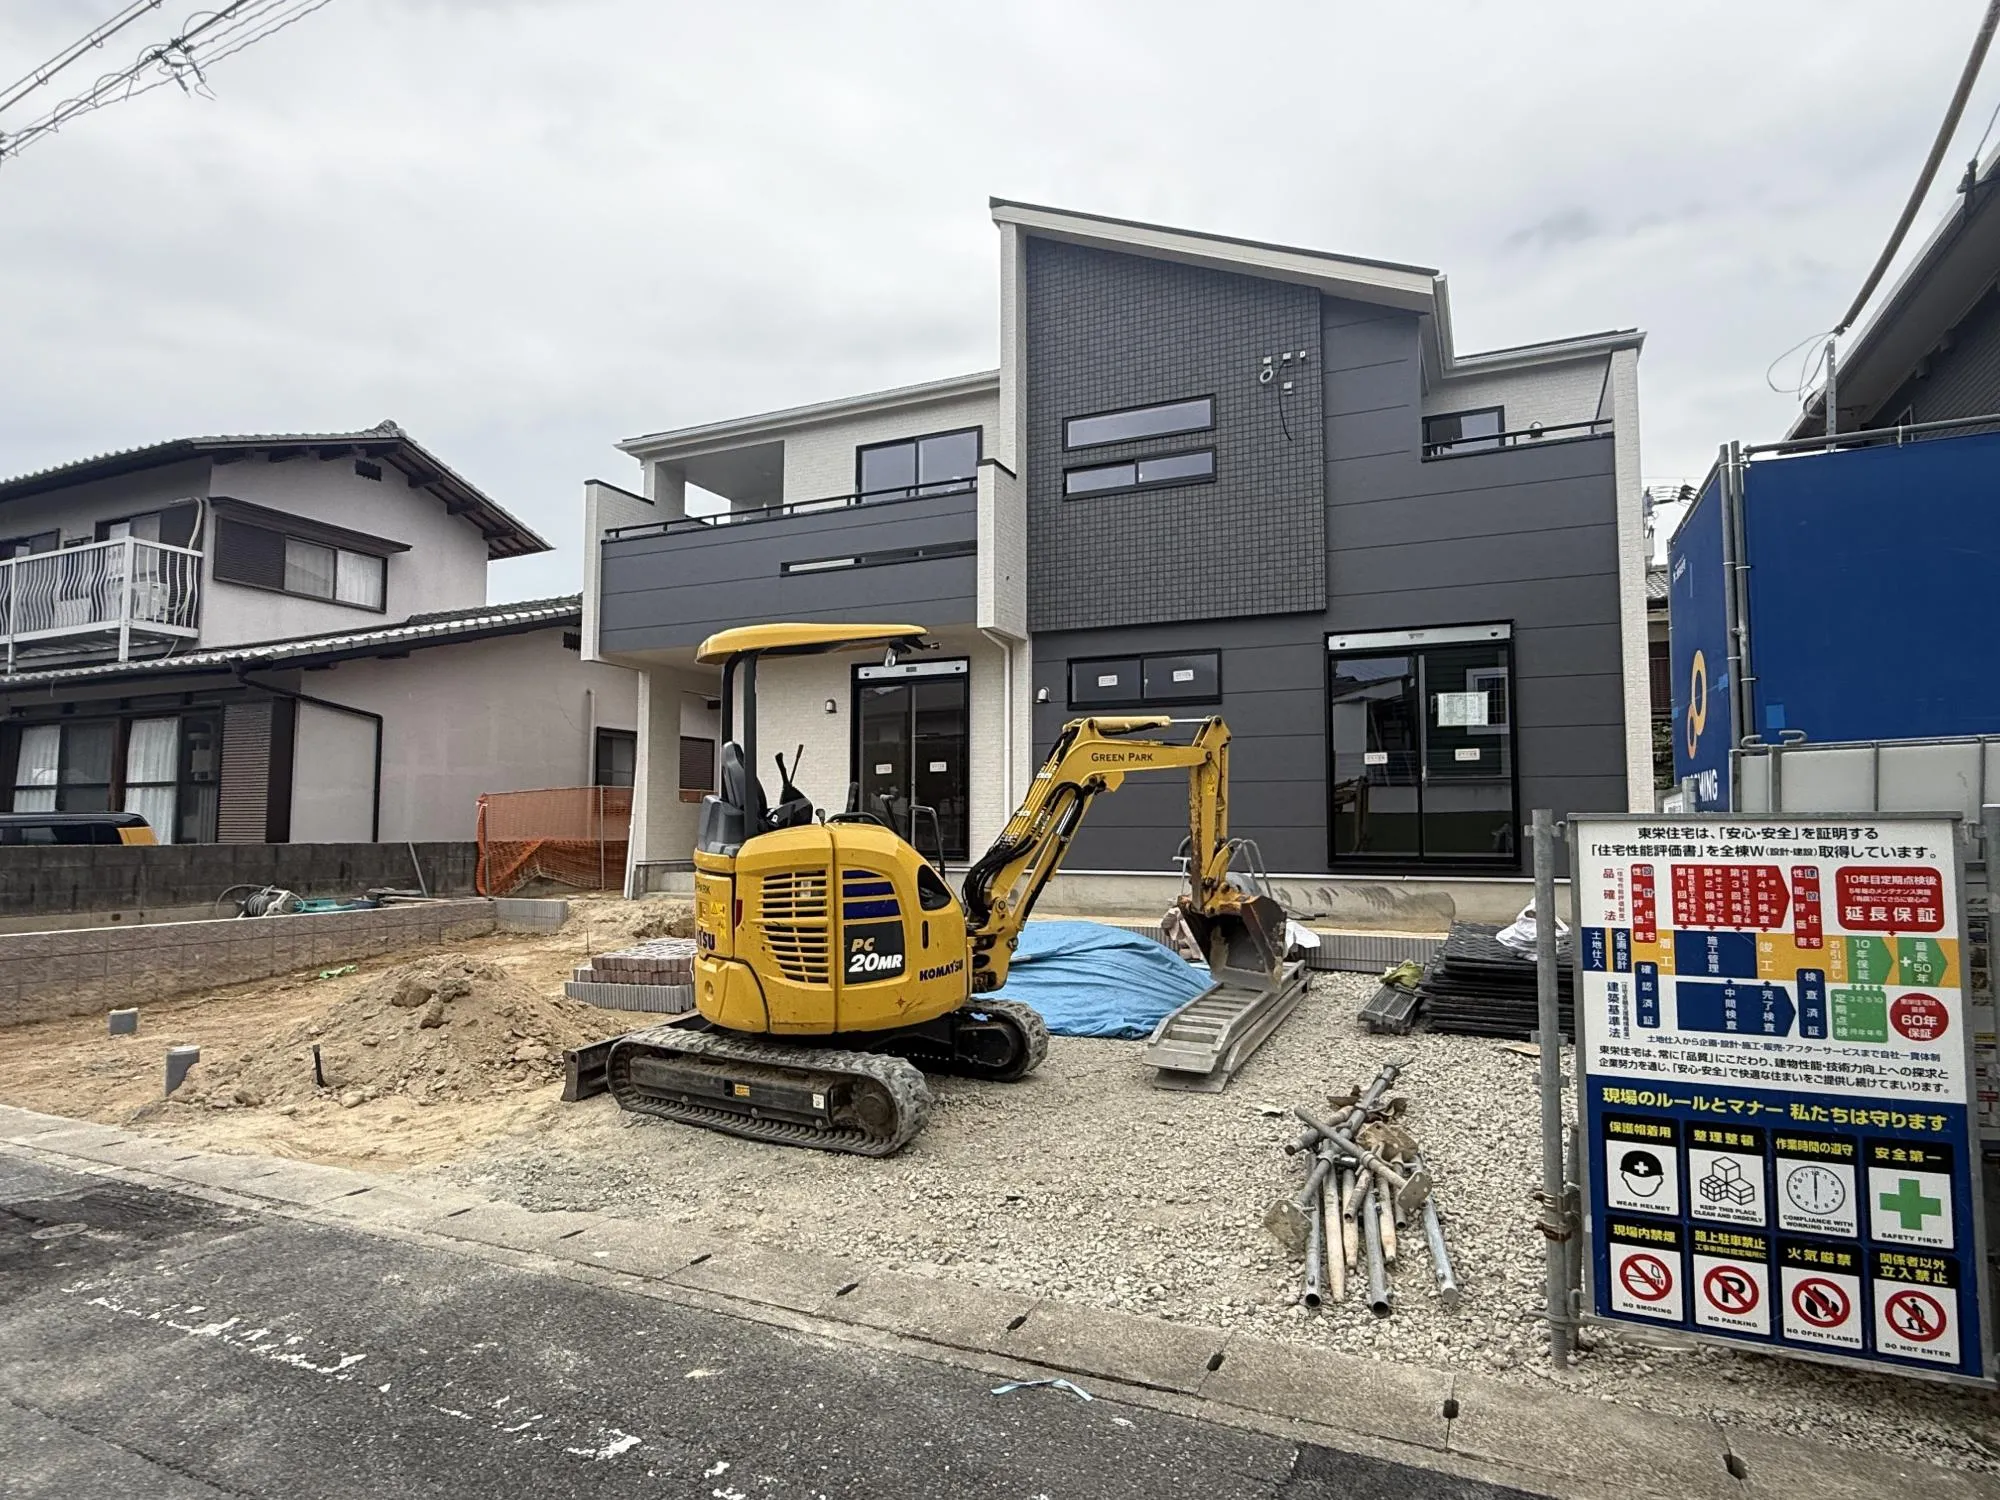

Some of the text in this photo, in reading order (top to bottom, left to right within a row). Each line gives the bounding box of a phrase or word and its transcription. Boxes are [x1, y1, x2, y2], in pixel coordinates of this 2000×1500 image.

[1091, 752, 1153, 762] GREEN PARK
[1845, 906, 1938, 924] 延長保証
[851, 937, 875, 953] PC
[1591, 930, 1603, 968] 土地仕入
[848, 952, 903, 973] 20MR
[919, 959, 964, 981] KOMATSU
[1901, 1015, 1938, 1027] 60年
[1908, 1029, 1932, 1039] 保証
[1602, 1087, 1947, 1131] 現場のルールとマナー 私たちは守ります
[1875, 1147, 1942, 1163] 安全第一
[1615, 1200, 1671, 1211] WEAR HELMET
[1735, 1208, 1757, 1216] PLACE
[1693, 1209, 1716, 1218] CLEAN
[1732, 1214, 1763, 1223] ORDERLY
[1782, 1214, 1854, 1228] COMPLIANCE WITH
[1785, 1221, 1851, 1234] WORKING HOURS
[1881, 1232, 1944, 1245] SAFETY FIRST
[1787, 1247, 1852, 1266] 火気厳禁
[1879, 1253, 1947, 1271] 関係者以外
[1880, 1266, 1948, 1285] 立入禁止
[1636, 1304, 1672, 1315] SMOKING
[1721, 1317, 1758, 1328] PARKING
[1801, 1329, 1824, 1339] OPEN
[1826, 1333, 1860, 1344] FLAMES
[1884, 1342, 1951, 1358] DO NOT ENTER
